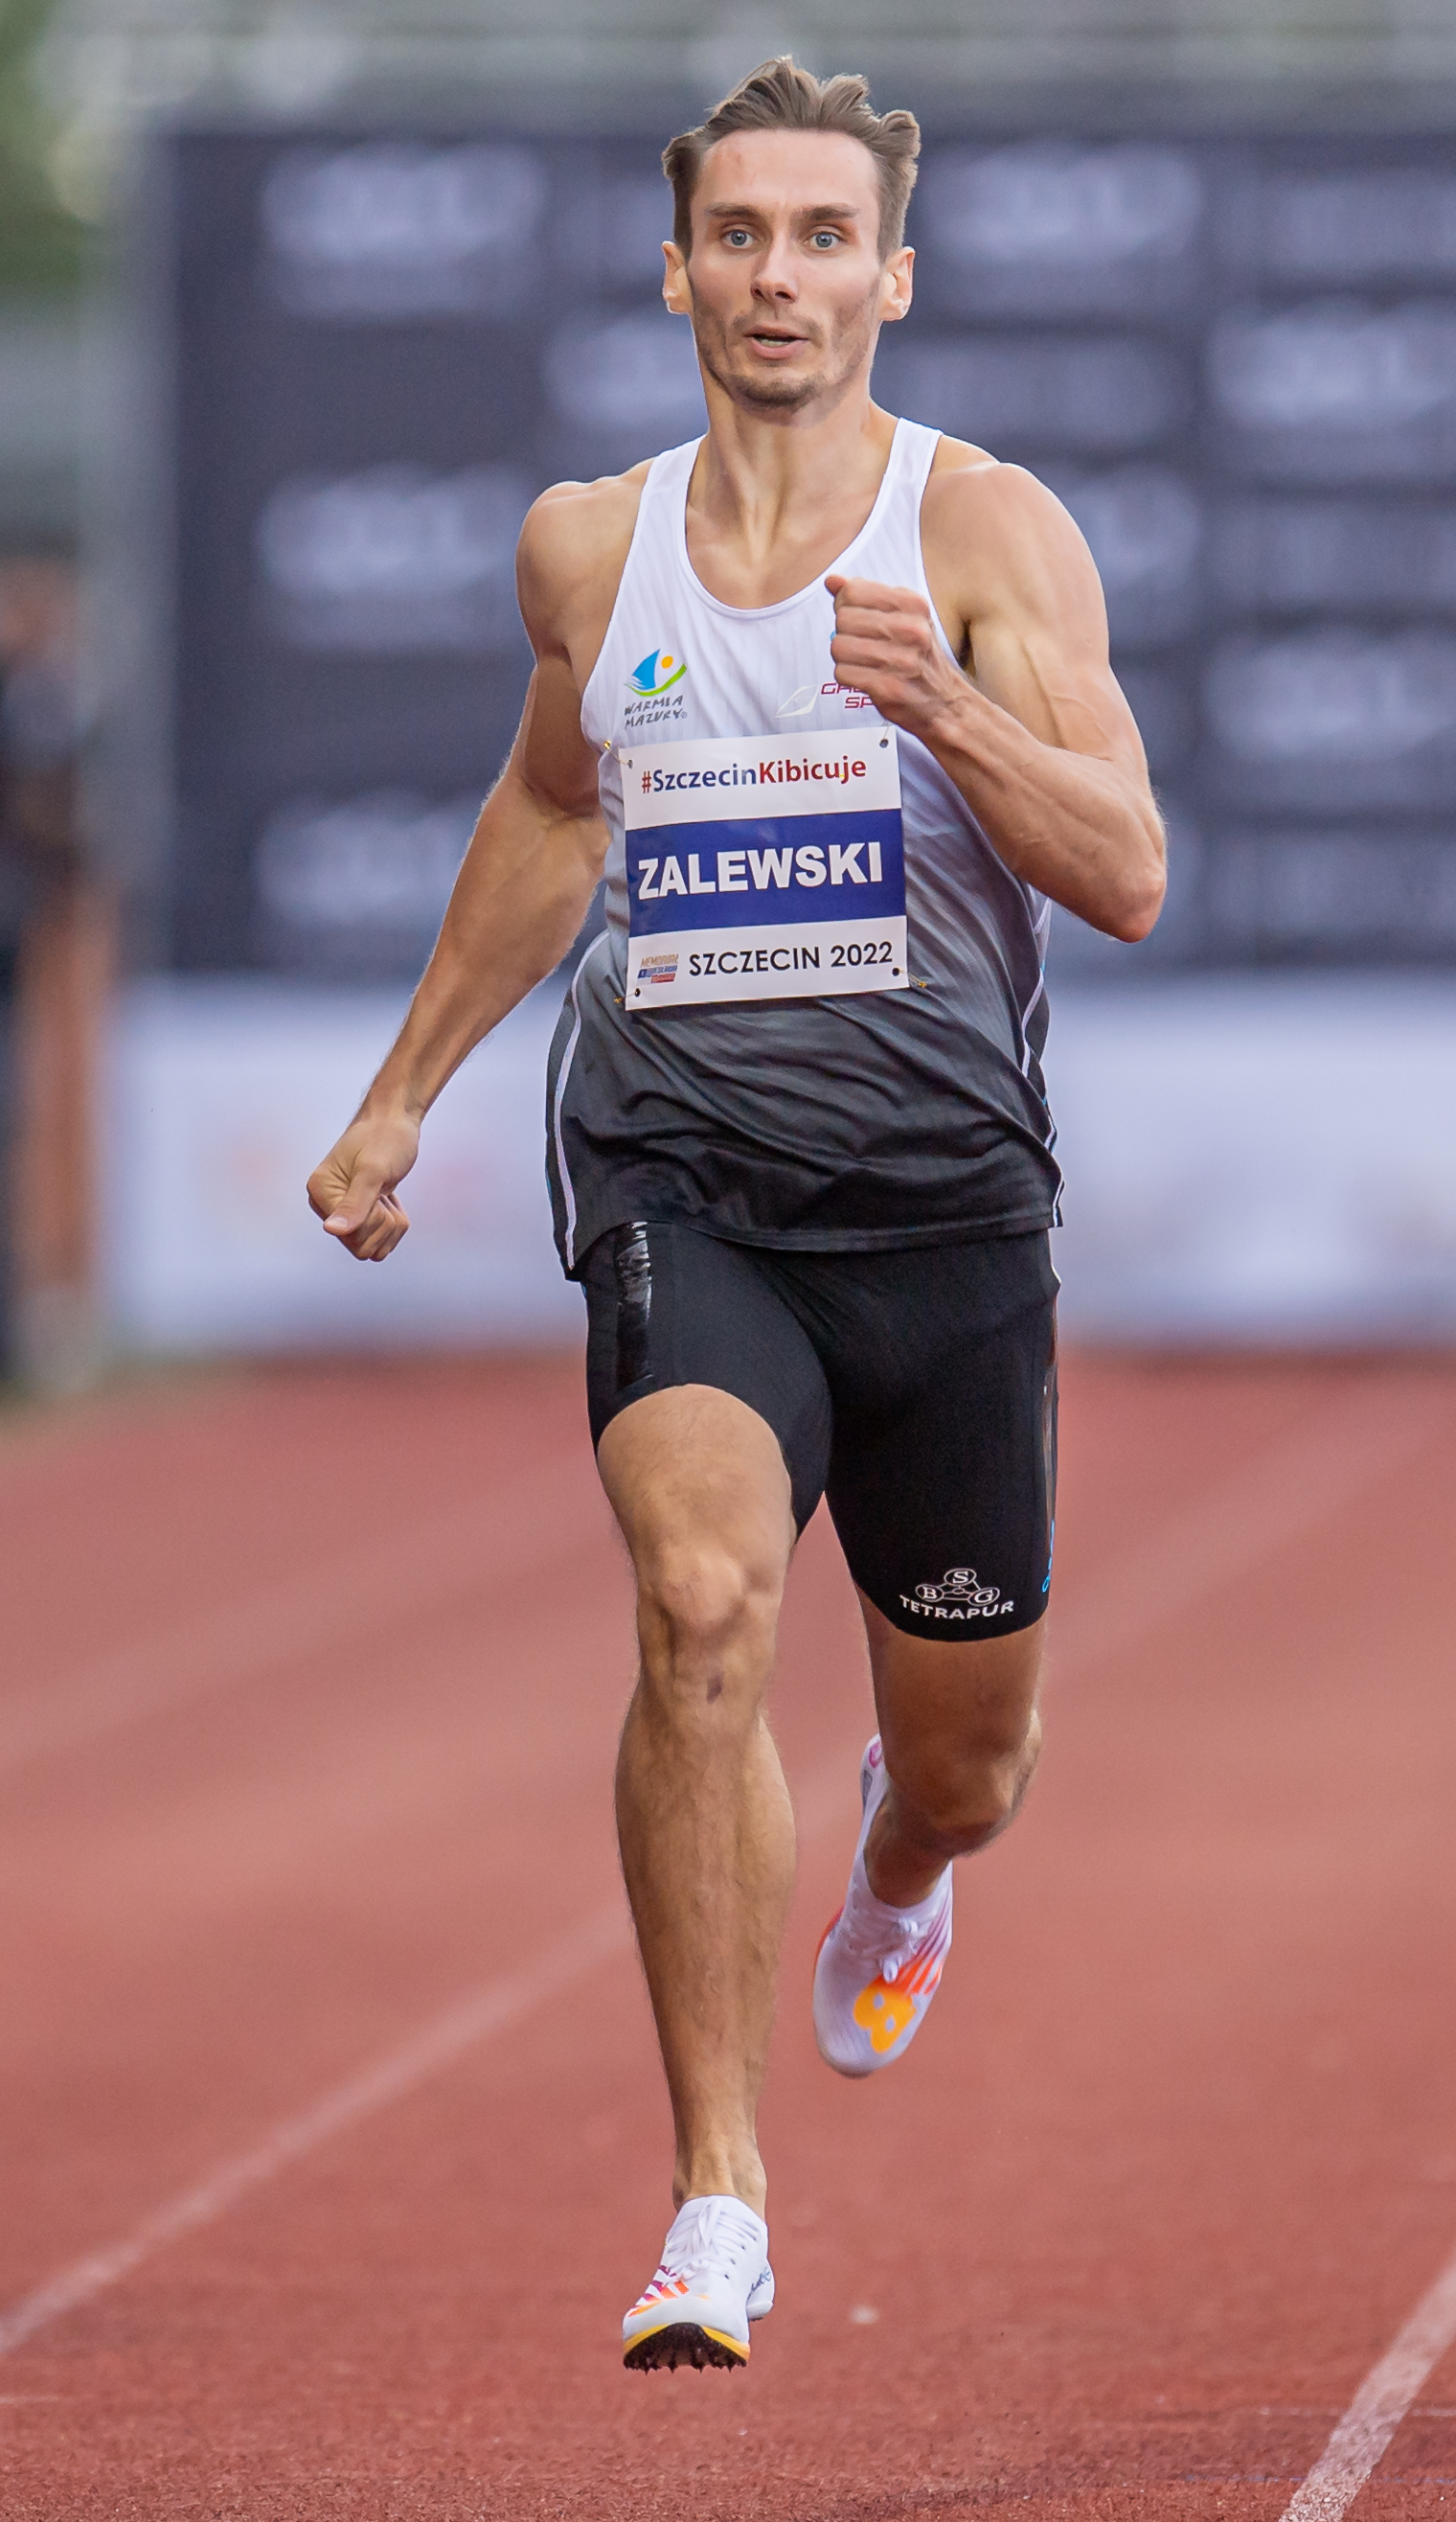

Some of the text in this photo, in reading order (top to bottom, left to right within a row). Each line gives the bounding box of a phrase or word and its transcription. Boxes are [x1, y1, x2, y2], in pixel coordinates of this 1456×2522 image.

[625, 694, 684, 717] WARMIA
[641, 755, 867, 794] #SzczecinKibicuje
[637, 840, 883, 901] ZALEWSKI
[689, 945, 821, 977] SZCZECIN
[830, 940, 893, 968] 2022
[899, 1593, 1015, 1620] TETRAPUR
